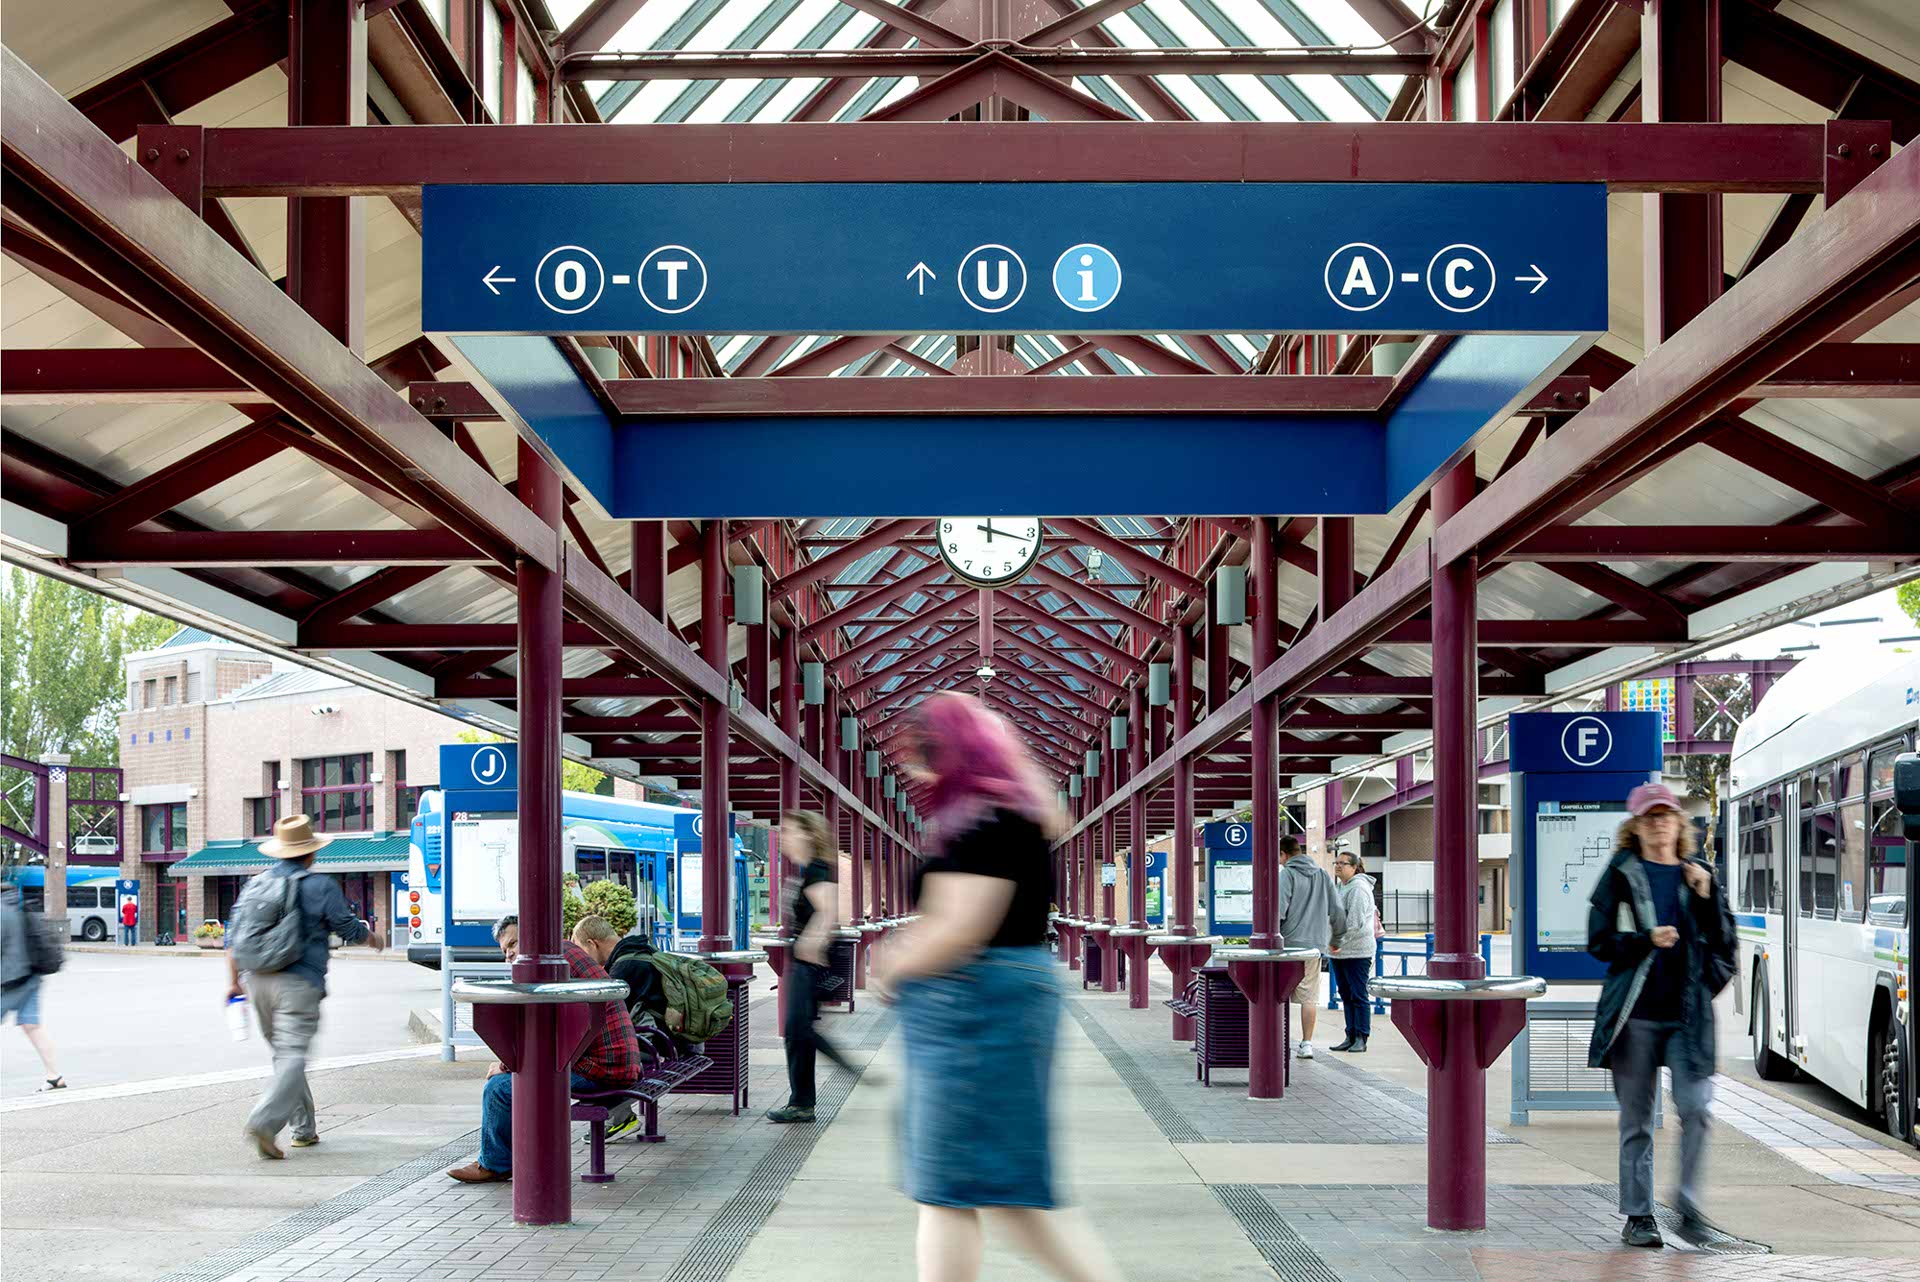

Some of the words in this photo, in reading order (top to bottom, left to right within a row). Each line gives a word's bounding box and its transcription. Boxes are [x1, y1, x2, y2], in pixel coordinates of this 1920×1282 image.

[977, 260, 1009, 301] U
[1076, 254, 1098, 301] i
[943, 523, 953, 533] 9
[1026, 527, 1036, 538] 3
[948, 543, 958, 554] 8
[1018, 547, 1027, 557] 4
[964, 560, 973, 570] 7
[1003, 562, 1012, 572] 5
[982, 566, 992, 576] 6
[1577, 727, 1599, 757] F
[481, 754, 496, 777] J
[455, 812, 468, 821] 28
[1230, 828, 1241, 842] E
